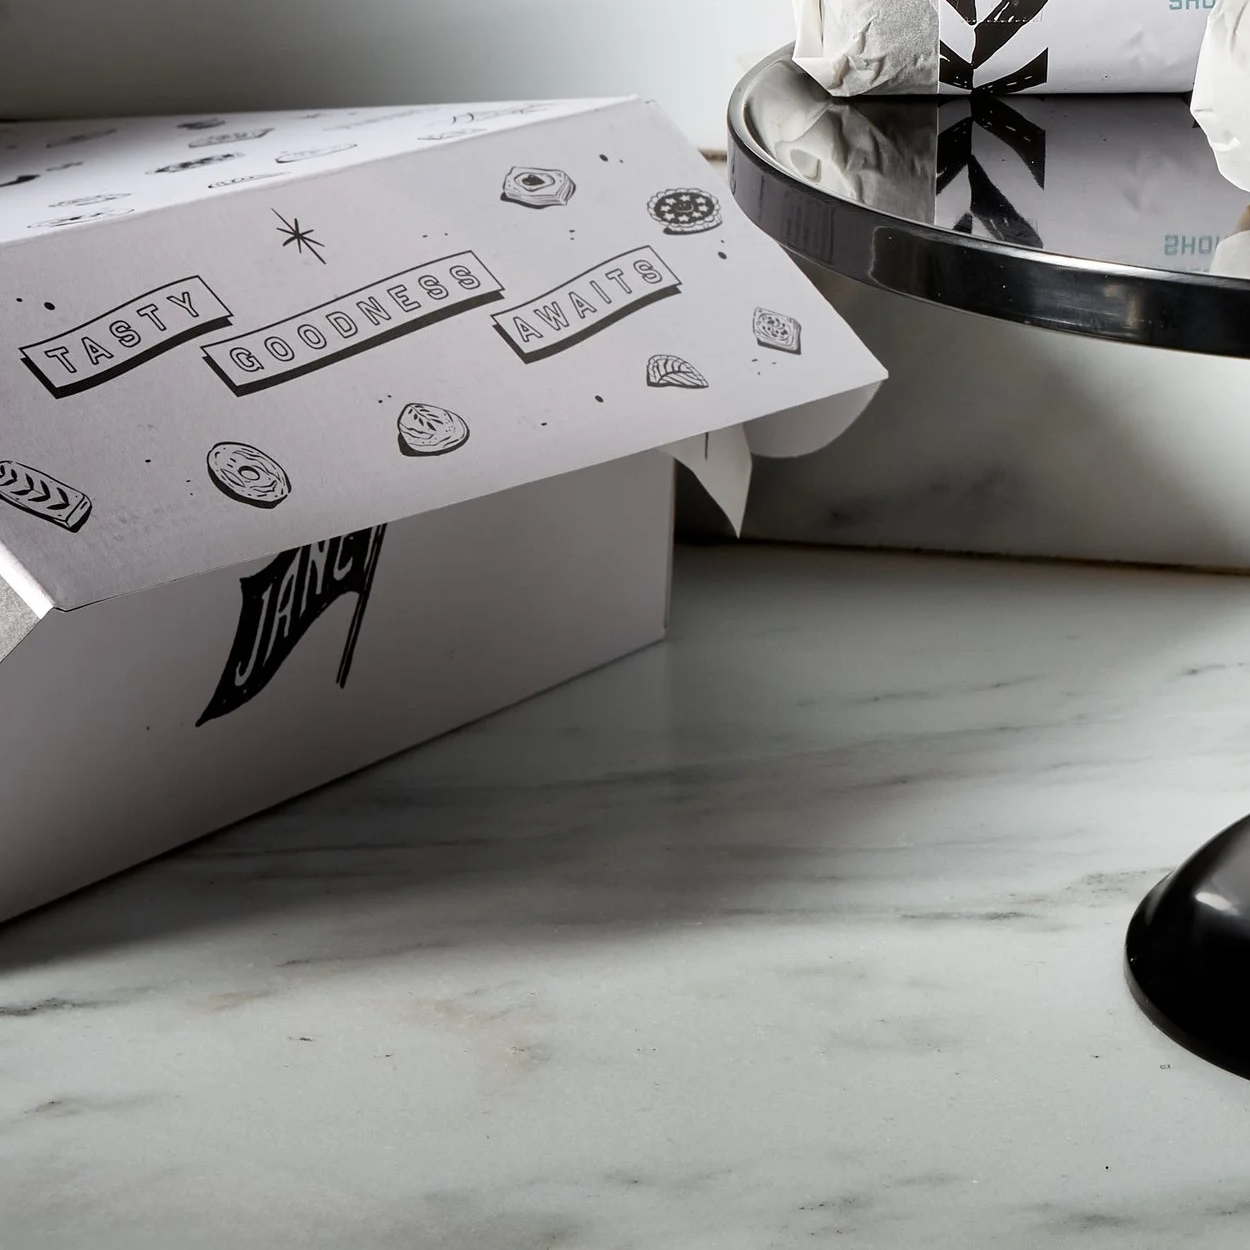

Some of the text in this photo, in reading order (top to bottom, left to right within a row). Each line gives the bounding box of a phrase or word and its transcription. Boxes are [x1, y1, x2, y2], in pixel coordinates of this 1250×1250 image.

[46, 258, 665, 374] TASTY GOODNESS AWAITS
